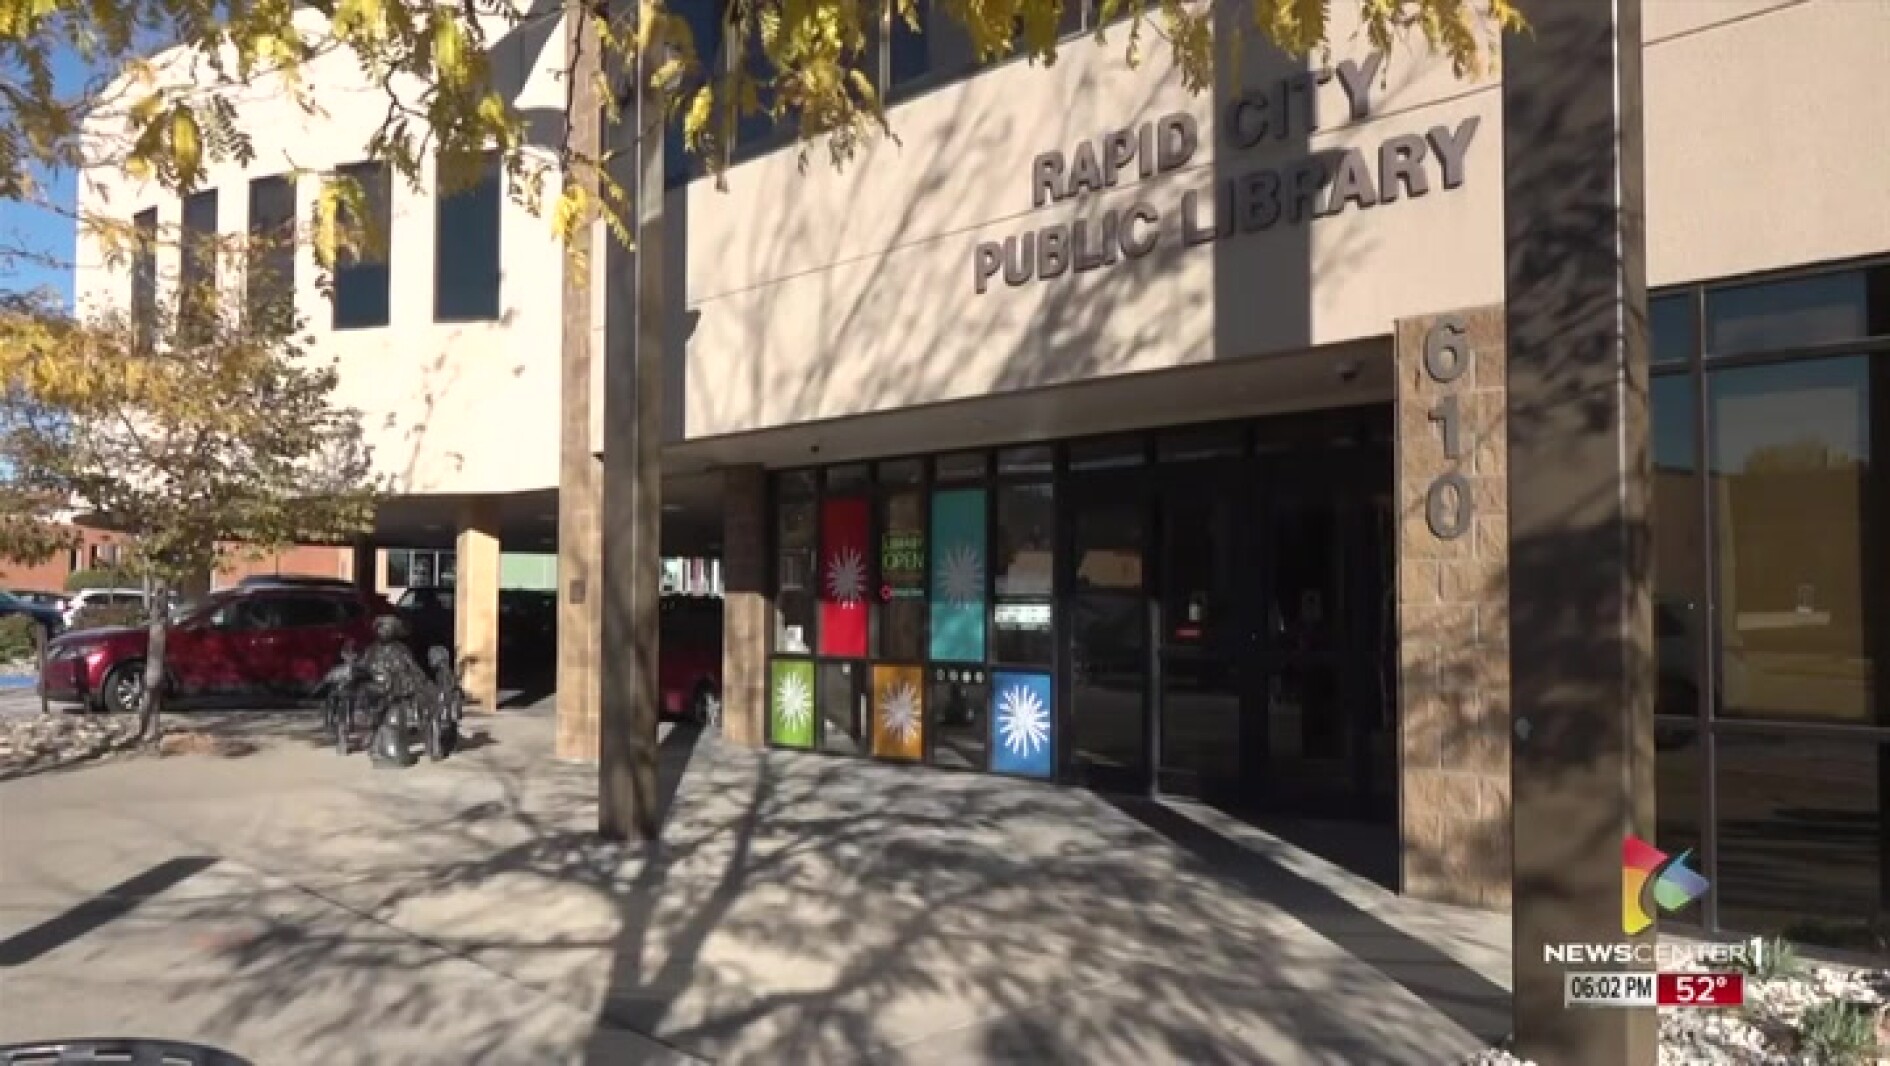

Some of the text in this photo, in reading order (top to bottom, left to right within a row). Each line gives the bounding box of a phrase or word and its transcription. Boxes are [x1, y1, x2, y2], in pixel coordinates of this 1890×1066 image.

[974, 116, 1480, 293] PUBLIC LIBRARY
[1033, 53, 1383, 207] RAPID CITY
[1423, 314, 1473, 541] 610
